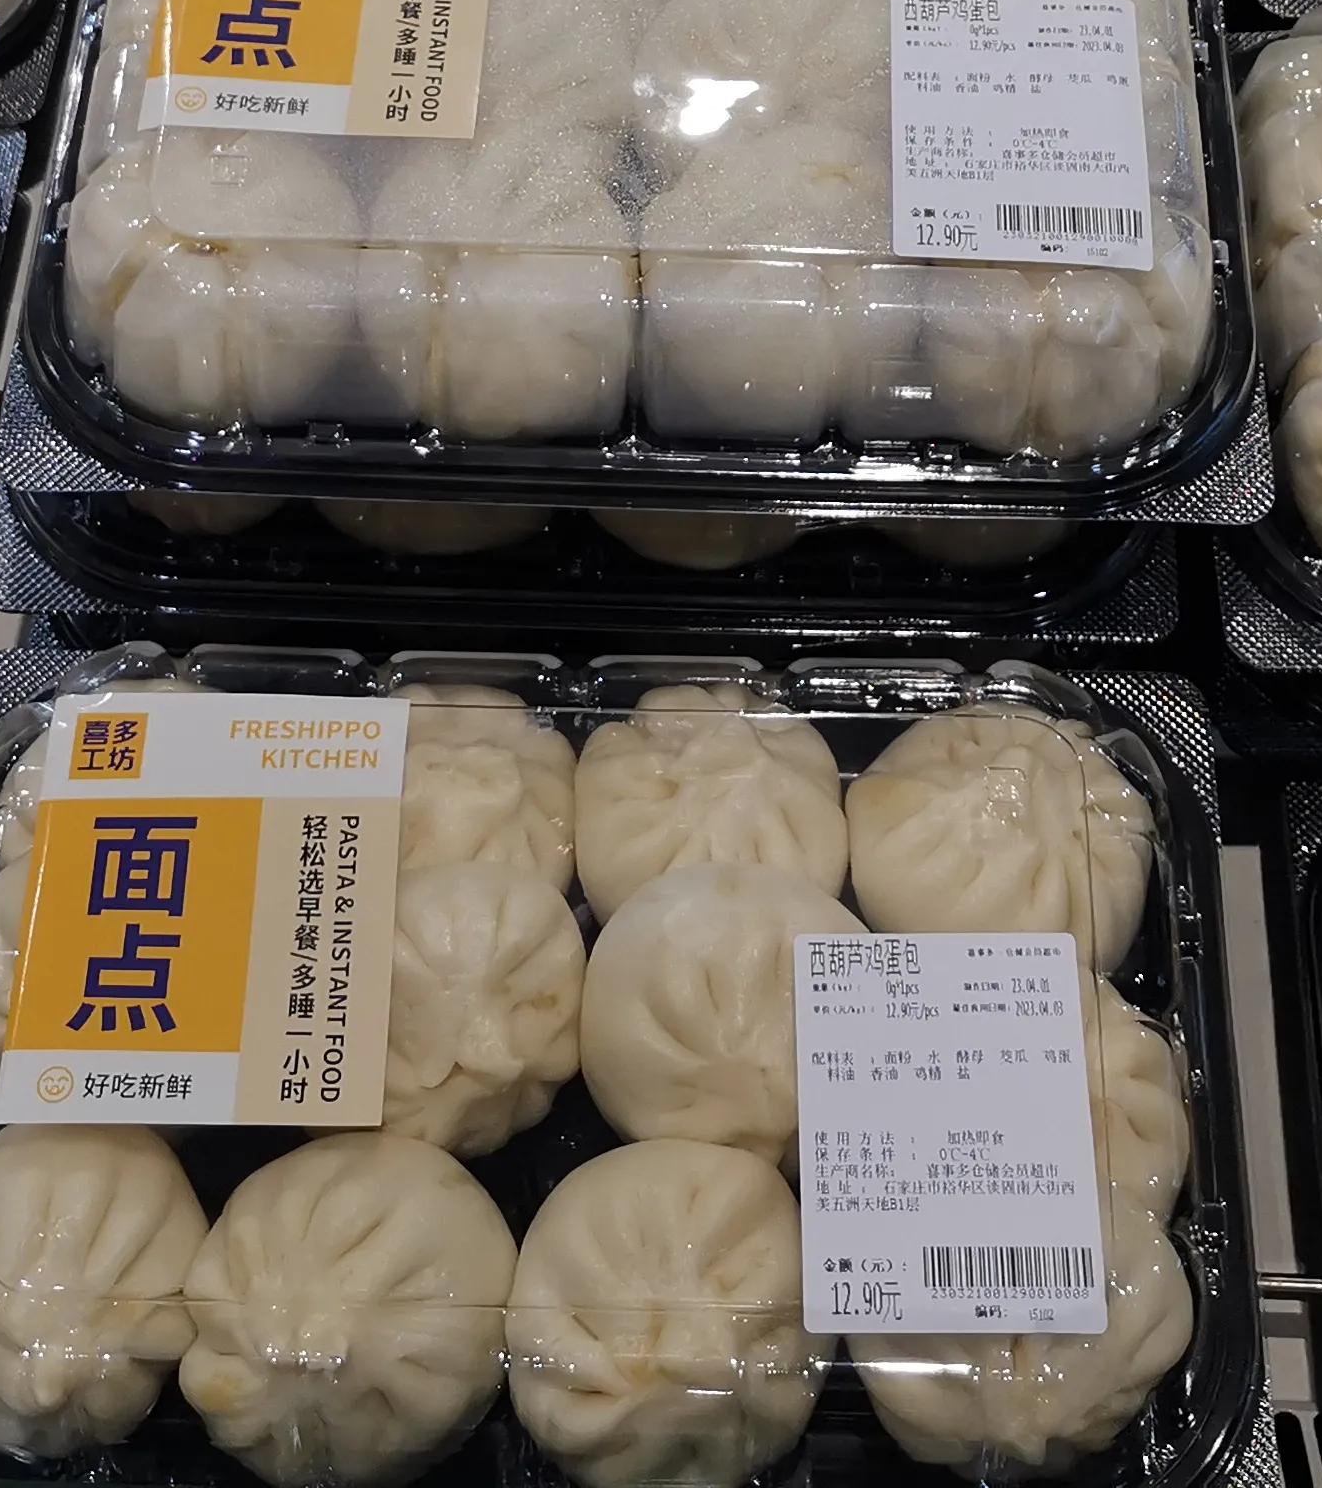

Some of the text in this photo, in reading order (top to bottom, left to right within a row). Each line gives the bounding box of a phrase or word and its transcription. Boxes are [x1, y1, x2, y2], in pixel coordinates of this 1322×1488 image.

[427, 0, 453, 72] INSTANT
[215, 93, 309, 115] 好吃新鲜
[420, 75, 442, 122] FOOD
[916, 224, 978, 251] 12.90元
[82, 720, 139, 745] 喜多
[229, 719, 382, 741] FRESHIPPO
[77, 747, 136, 772] 工坊
[261, 748, 380, 769] KITCHEN
[335, 815, 360, 891] PASTA
[66, 816, 198, 1033] 面点
[280, 814, 329, 1104] 轻松选早餐/多睡一小时
[325, 921, 354, 1027] INSTANT
[808, 939, 922, 978] 西葫芦鸡蛋包
[82, 1073, 193, 1100] 好吃新鲜
[320, 1034, 346, 1103] FOOD
[831, 1281, 903, 1323] 12.90元
